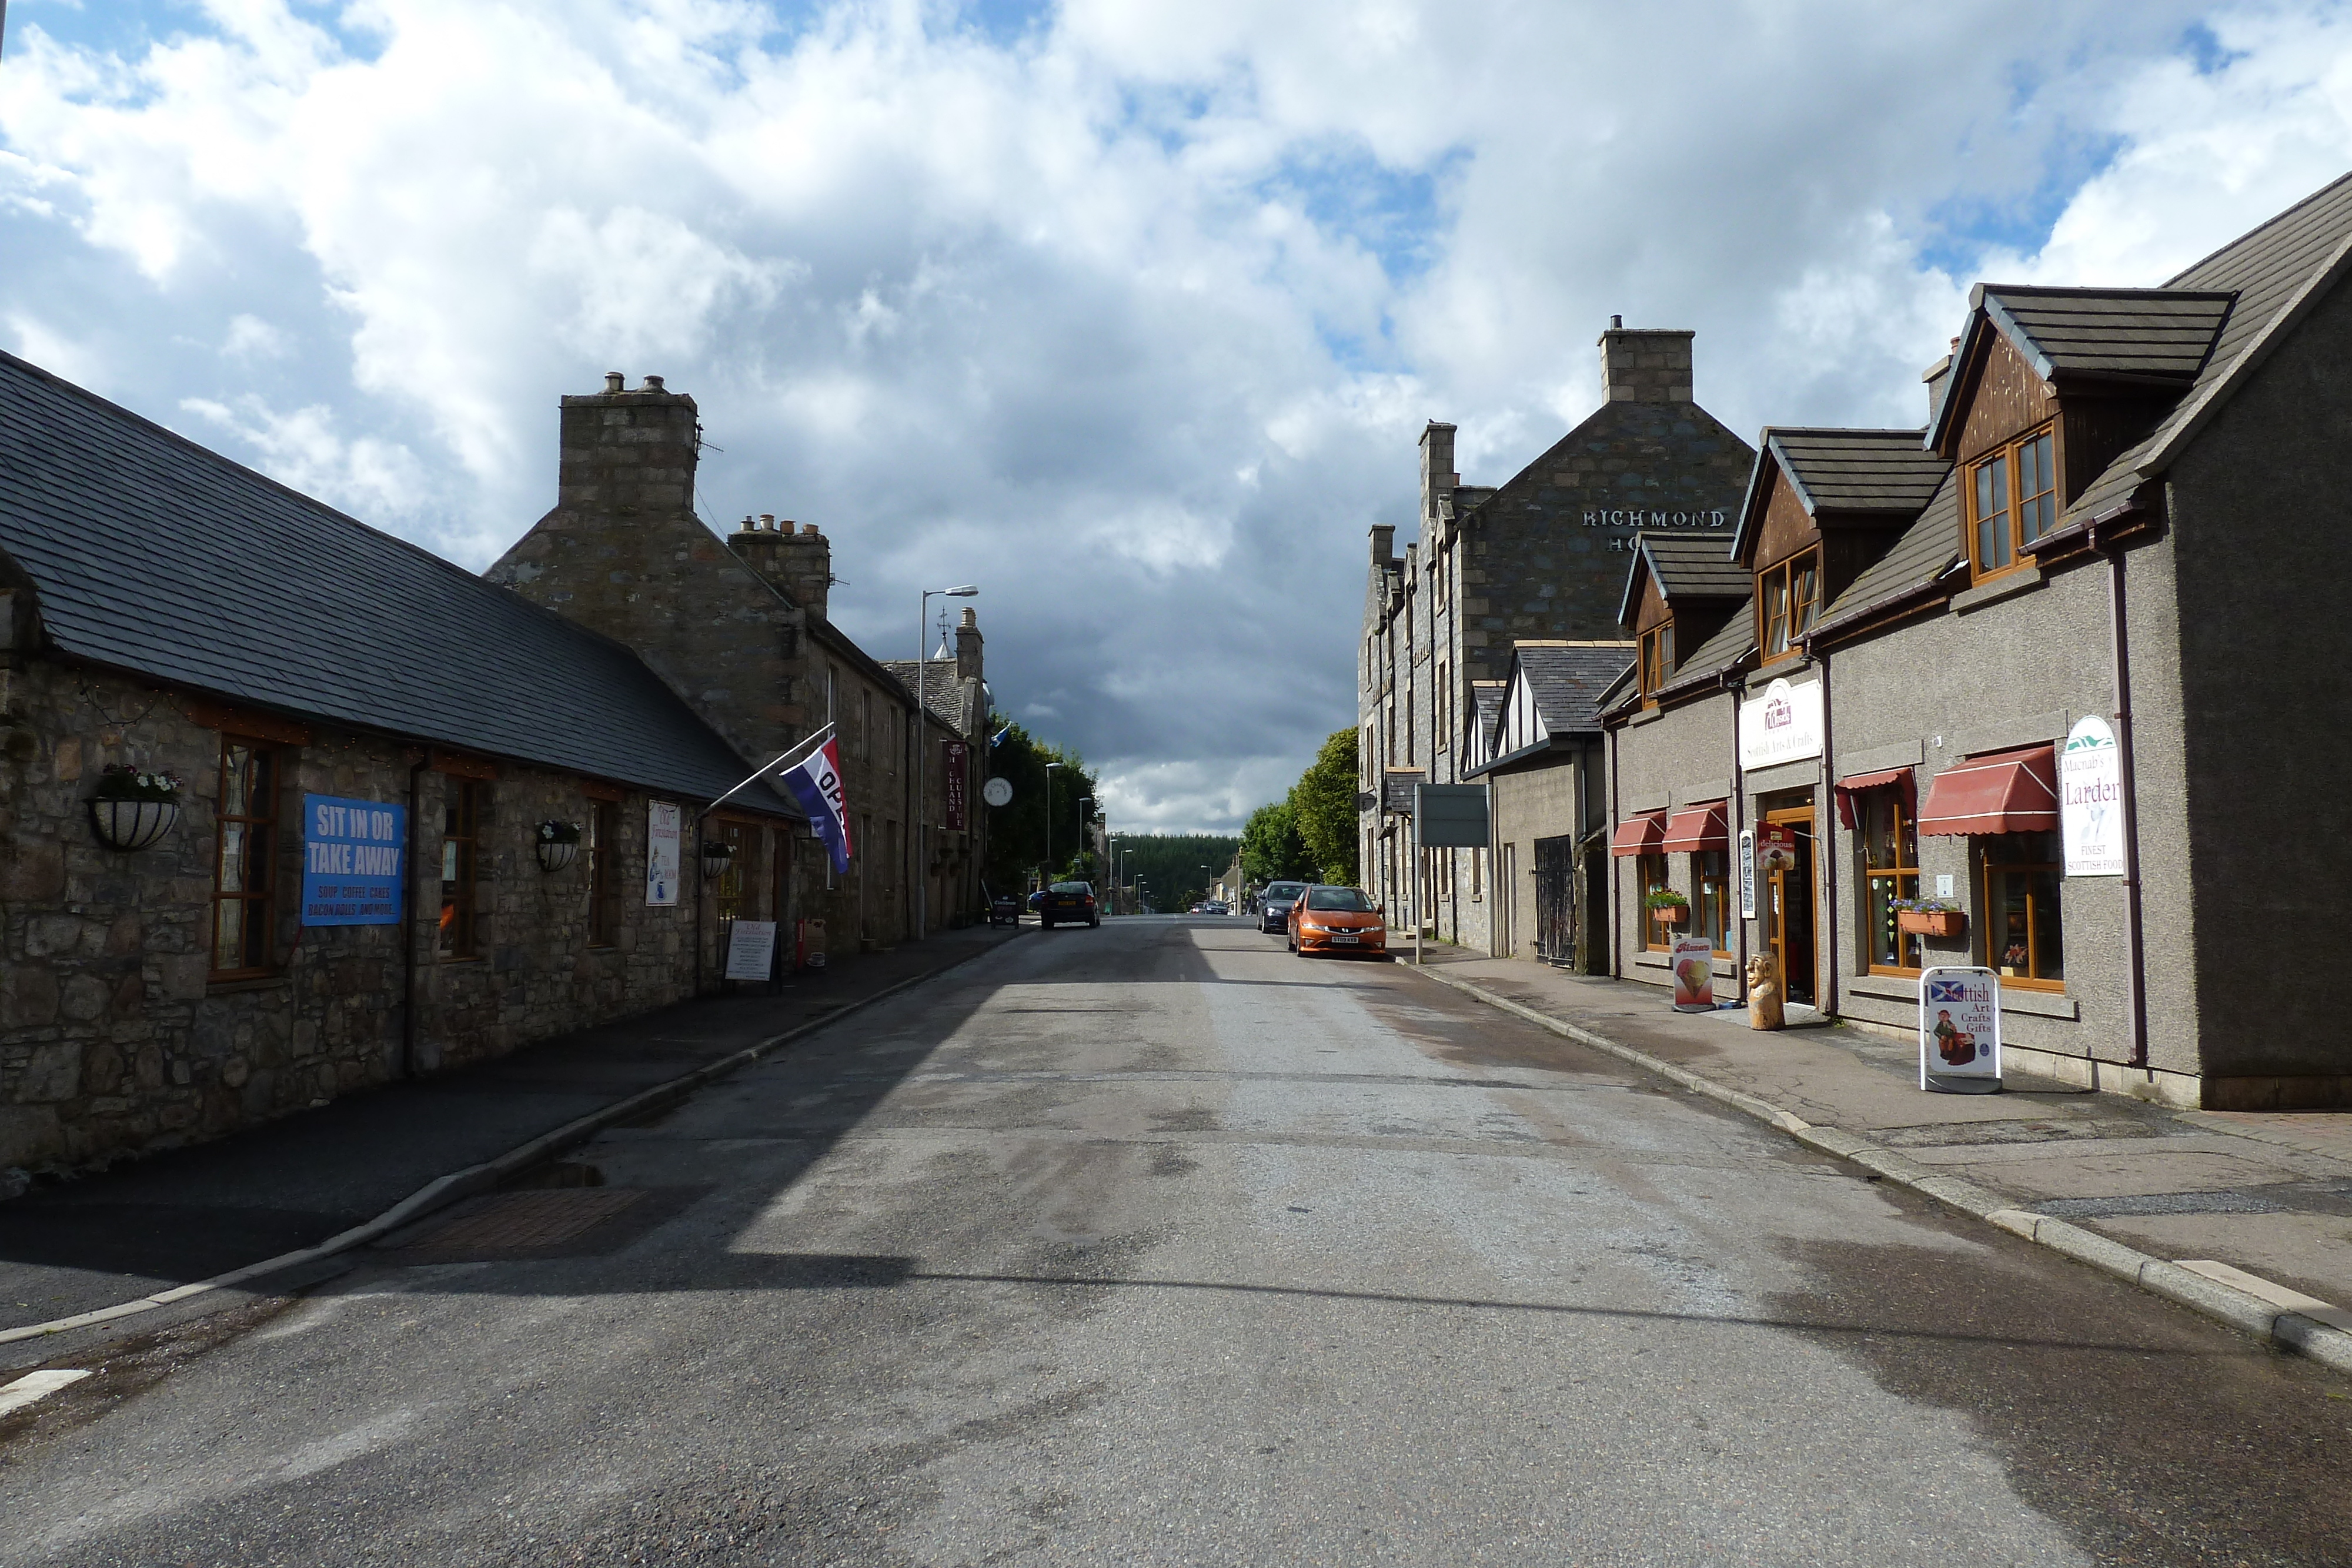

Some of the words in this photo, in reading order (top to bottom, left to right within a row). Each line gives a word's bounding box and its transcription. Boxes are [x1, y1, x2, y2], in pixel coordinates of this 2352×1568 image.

[1582, 510, 1725, 527] RICHMOND
[1747, 741, 1769, 758] Scottish
[1772, 740, 1785, 753] Arts
[1793, 731, 1813, 748] Crafts
[2064, 755, 2104, 773] Macnab's
[2065, 777, 2120, 805] Larder
[318, 804, 346, 837] SIT
[350, 808, 367, 838] IN
[372, 811, 393, 841] OR
[1760, 840, 1793, 848] delicious
[2081, 845, 2106, 855] FINEST
[309, 842, 351, 874] TAKE
[355, 845, 400, 875] AWAY
[2067, 860, 2101, 871] SCOTTISH
[2103, 859, 2123, 870] FOOD
[318, 885, 338, 898] SOUP
[343, 886, 366, 898] COFFEE
[370, 887, 390, 898] CAKES
[308, 904, 333, 916] BACON
[335, 904, 356, 915] ROLLS
[360, 904, 373, 915] AND
[1945, 983, 1990, 1002] Scottish
[1972, 1004, 1990, 1012] Art
[1961, 1013, 1991, 1022] Crafts
[1966, 1023, 1992, 1032] Gifts
